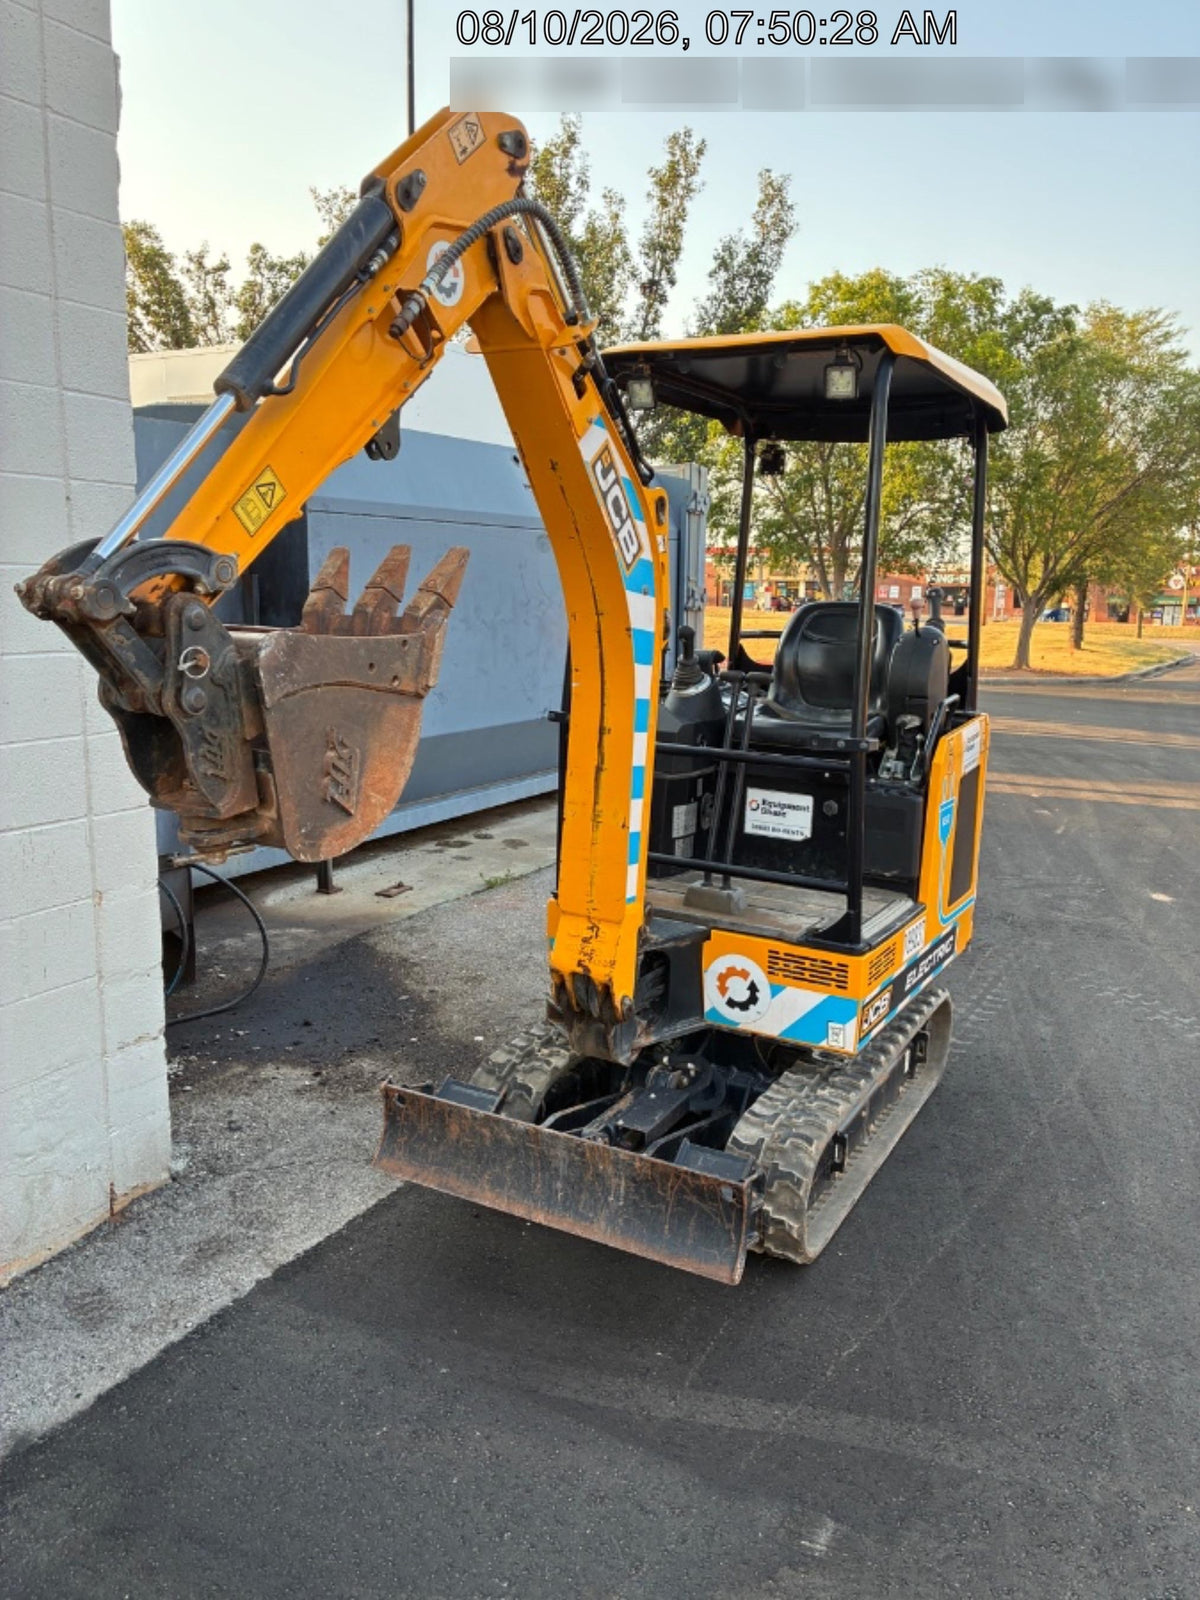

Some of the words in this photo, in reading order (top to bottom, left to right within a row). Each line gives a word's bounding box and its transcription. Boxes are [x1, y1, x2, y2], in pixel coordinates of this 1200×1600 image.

[594, 450, 640, 566] JCB
[862, 992, 890, 1030] JCB
[904, 934, 954, 992] ELECTRIC
